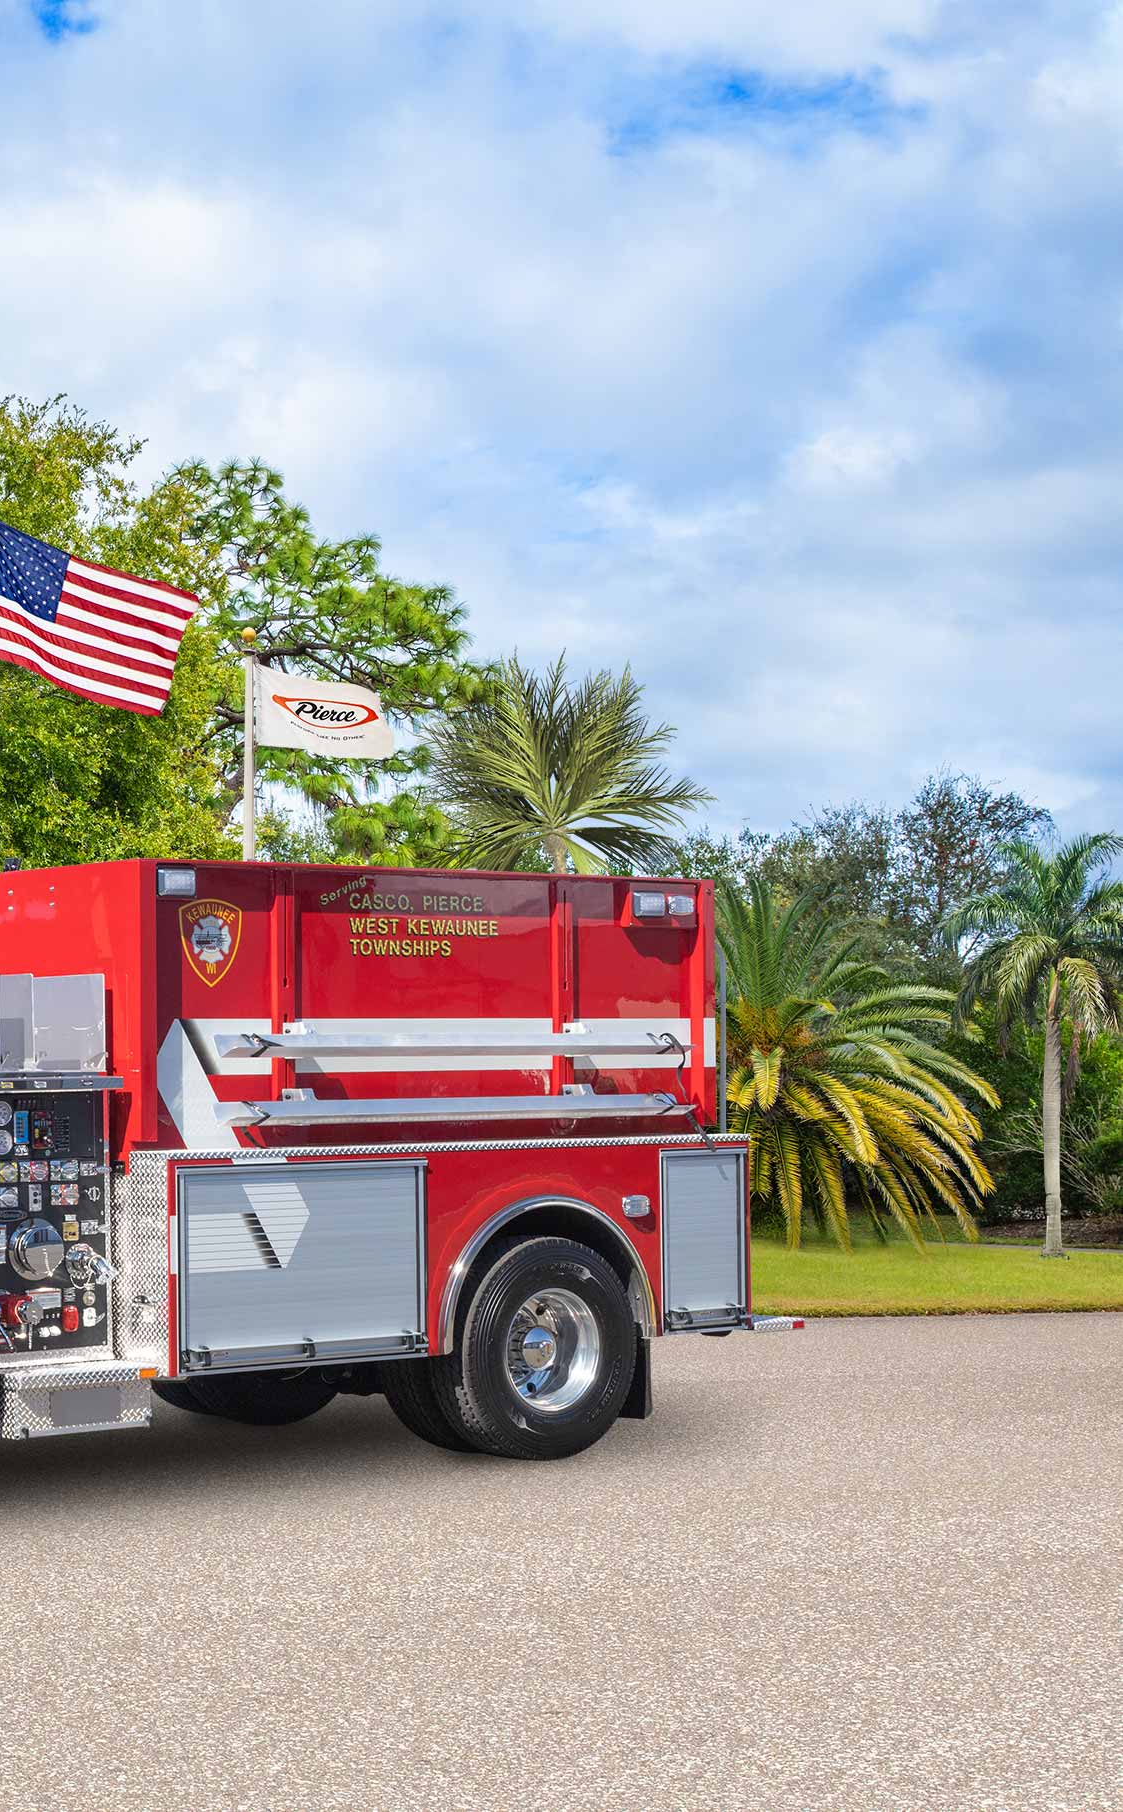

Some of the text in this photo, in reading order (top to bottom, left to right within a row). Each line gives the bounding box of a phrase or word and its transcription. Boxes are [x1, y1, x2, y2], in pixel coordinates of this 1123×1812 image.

[295, 701, 356, 722] Pierce
[319, 874, 368, 906] Serving
[349, 893, 483, 913] CASCO, PIERCE
[185, 903, 236, 924] KEWAUNEE
[349, 917, 499, 937] WEST KEWAUNEE
[350, 938, 452, 957] TOWNSHIPS
[205, 962, 217, 975] WI
